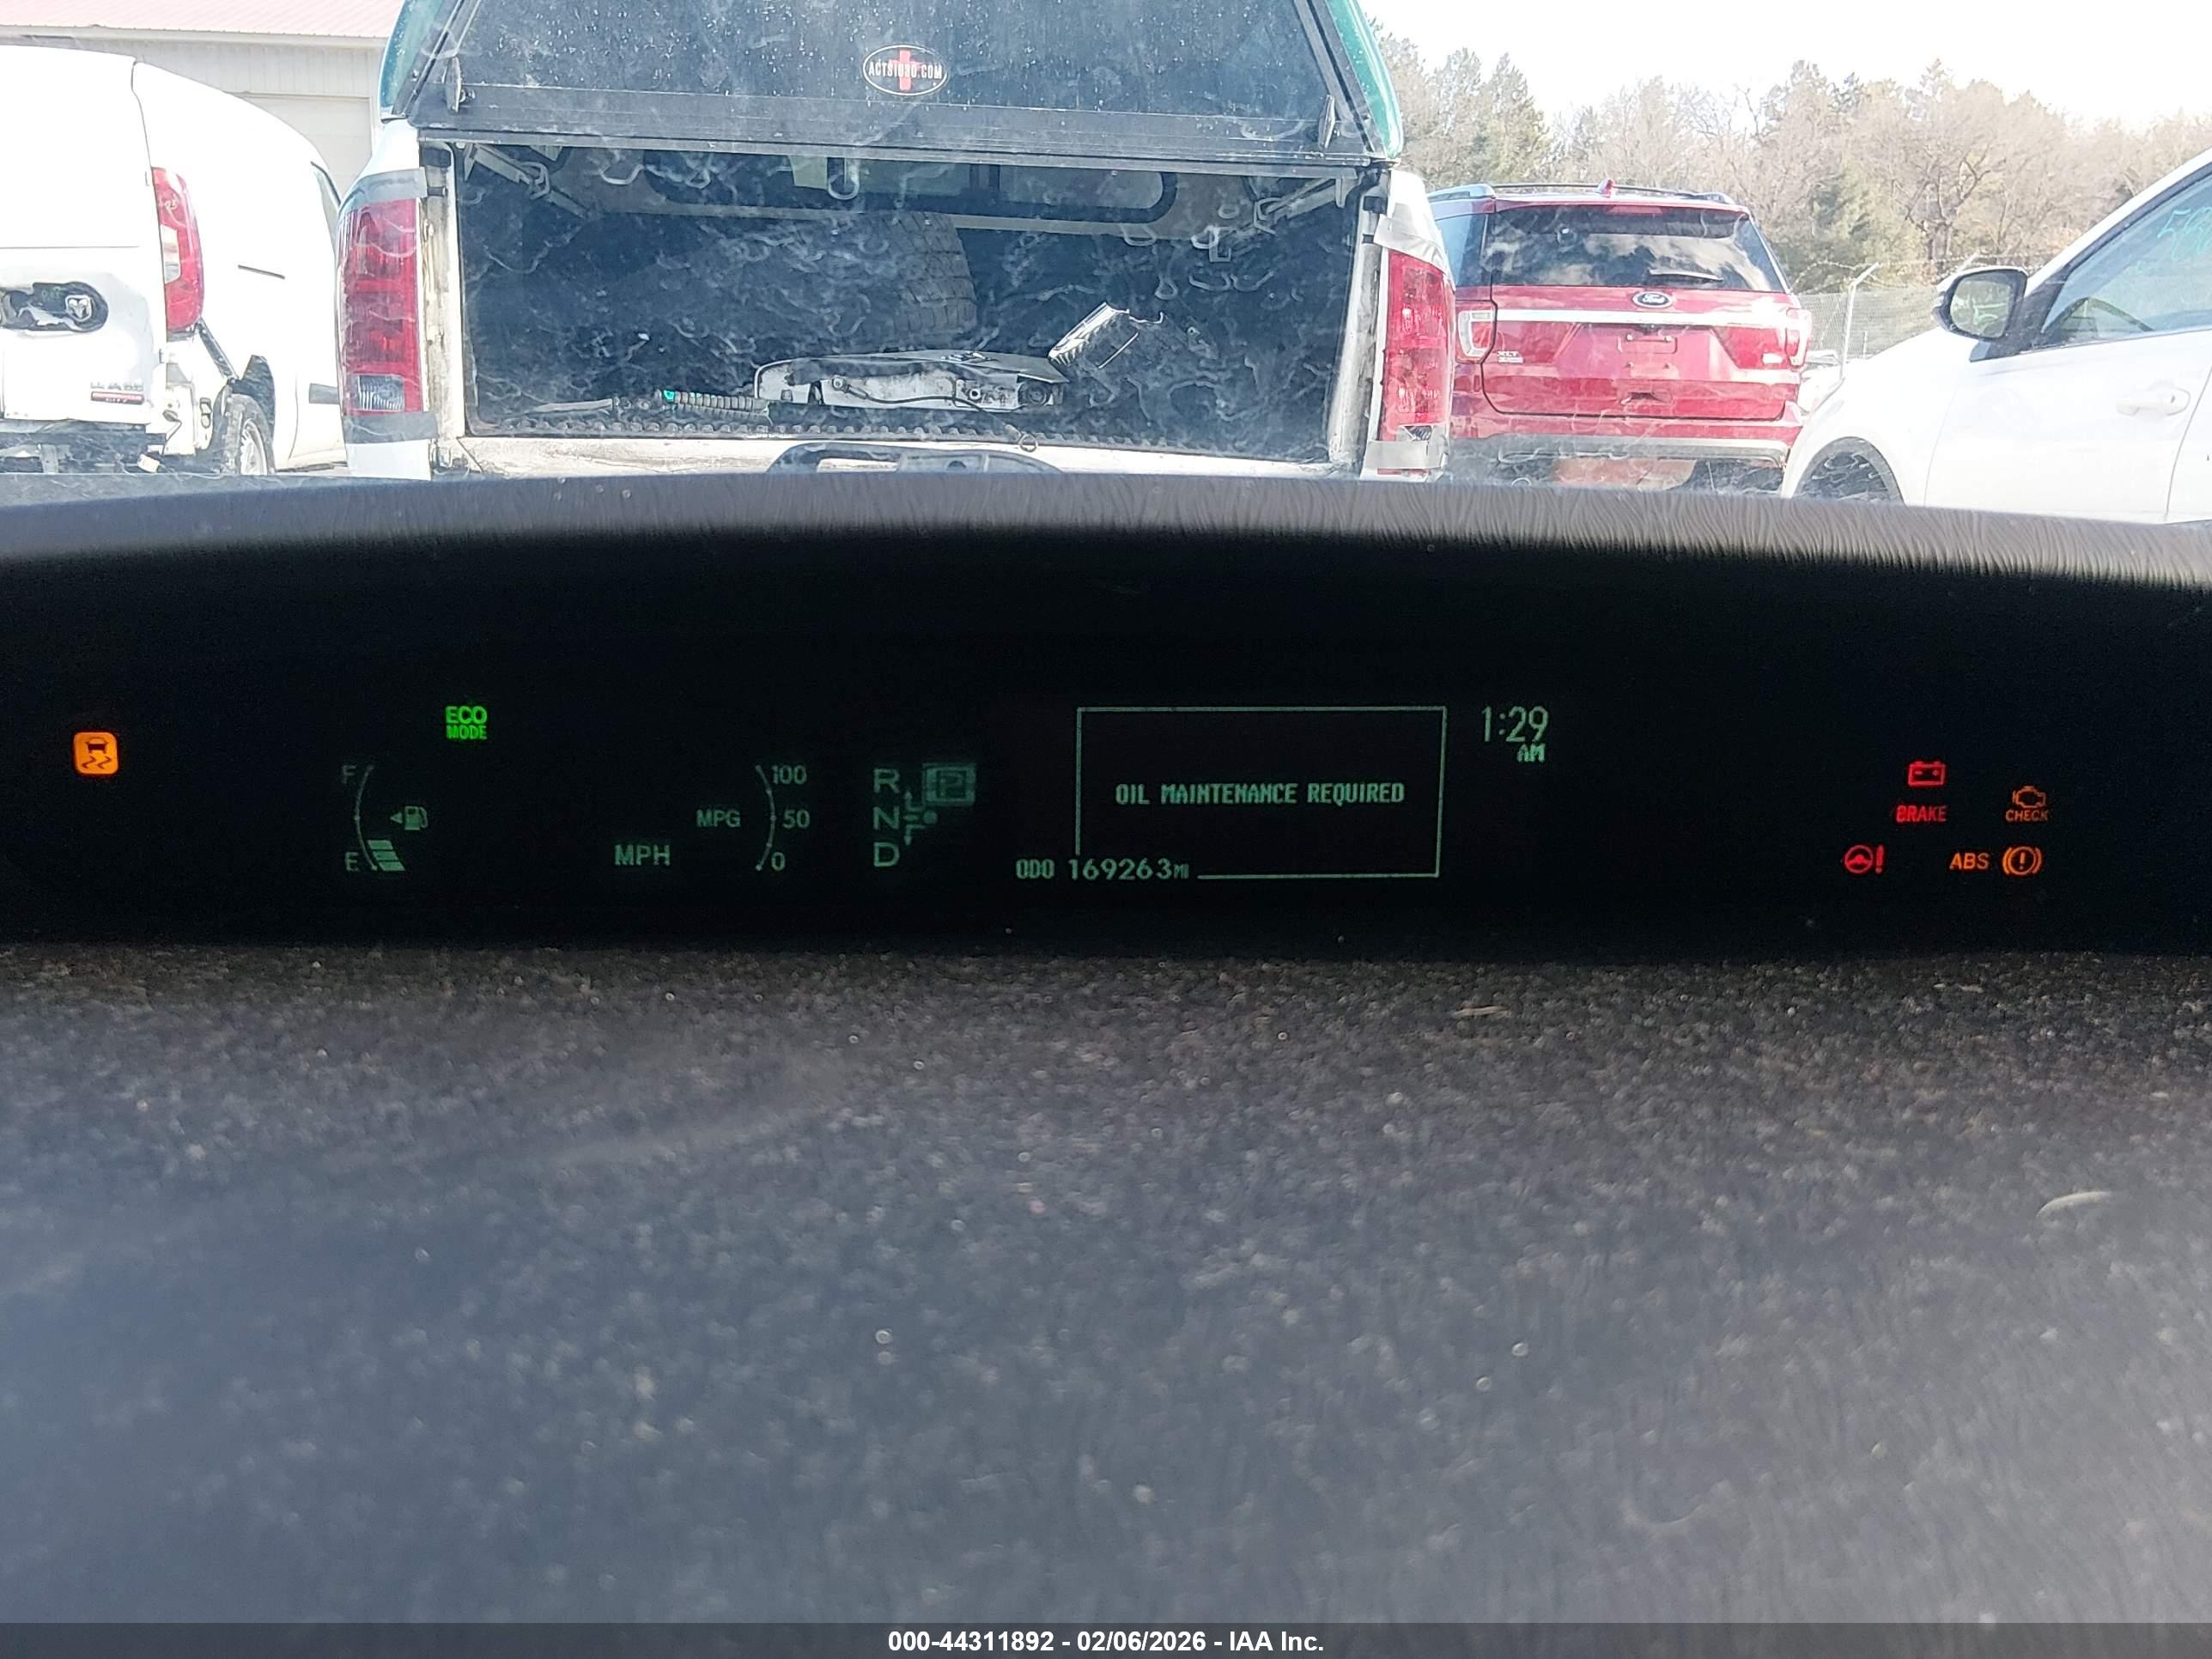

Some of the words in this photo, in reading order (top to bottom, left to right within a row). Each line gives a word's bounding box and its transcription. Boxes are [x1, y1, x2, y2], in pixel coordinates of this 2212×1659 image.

[446, 706, 487, 726] ECO
[1482, 707, 1548, 743] 1:29
[447, 726, 486, 739] MODE
[1517, 744, 1545, 762] AM
[342, 765, 356, 784] F
[772, 765, 806, 784] 100
[874, 769, 900, 793] R
[1116, 784, 1149, 805] OIL
[1161, 783, 1297, 804] MAINTENANCE
[1308, 783, 1404, 806] REQUIRED
[697, 810, 740, 827] MPG
[783, 810, 810, 829] 50
[873, 806, 899, 830] N
[1896, 805, 1947, 823] BRAKE
[2006, 809, 2051, 822] CHECK
[345, 852, 359, 871] E
[615, 845, 670, 866] MPH
[774, 852, 785, 871] 0
[874, 842, 899, 866] D
[1950, 853, 1988, 870] ABS
[1017, 859, 1054, 878] ODO
